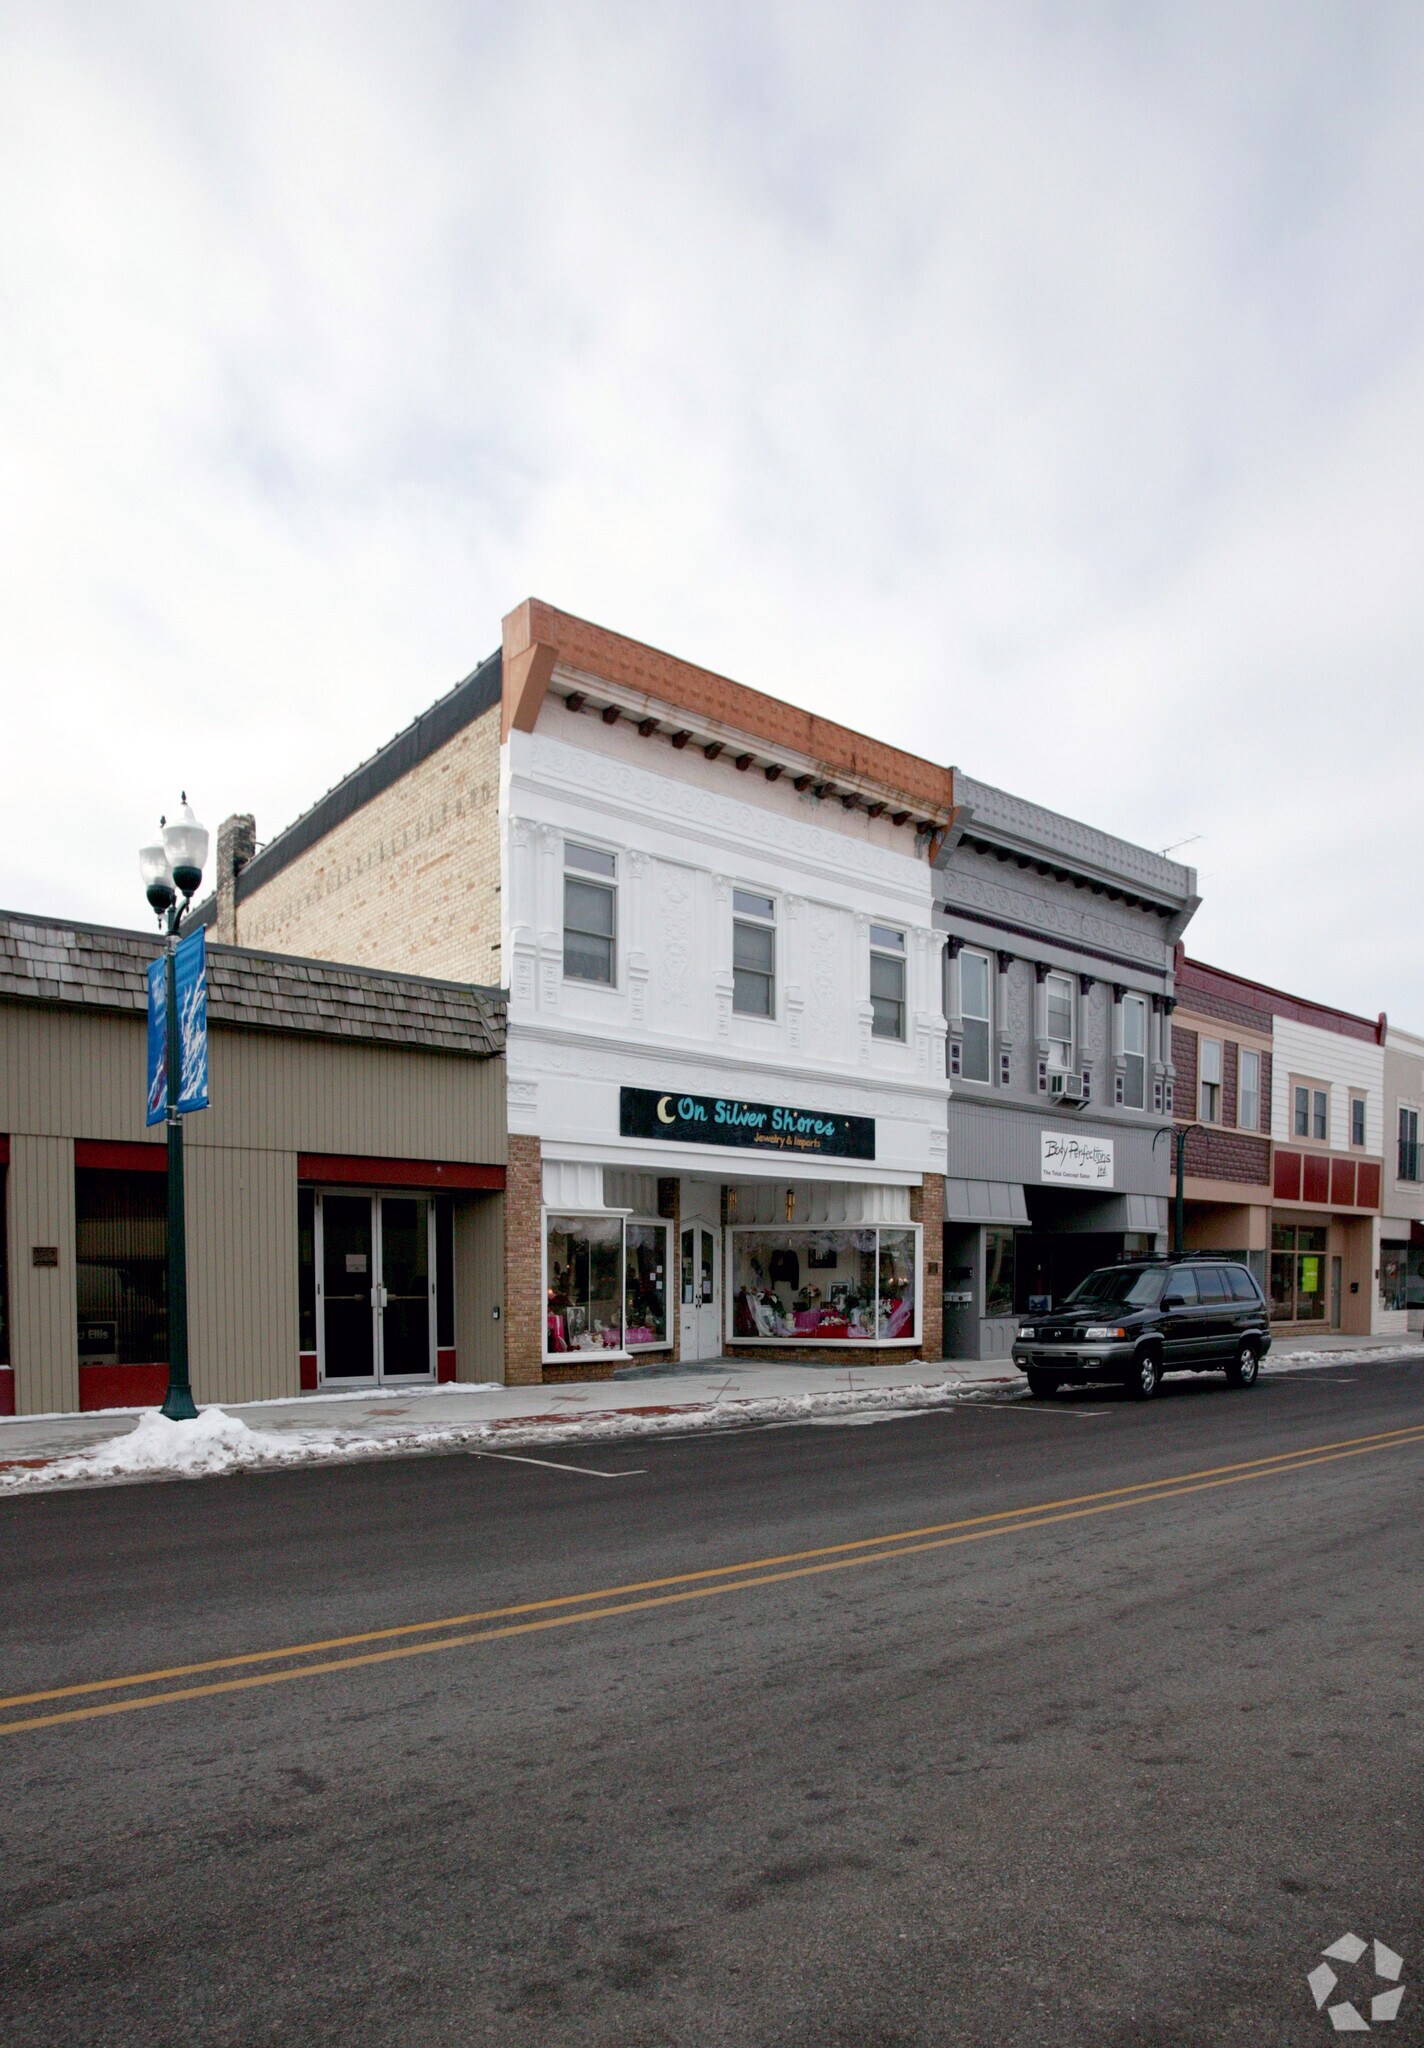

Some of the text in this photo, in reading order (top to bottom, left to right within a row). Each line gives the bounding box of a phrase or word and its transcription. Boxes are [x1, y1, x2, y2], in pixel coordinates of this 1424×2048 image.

[677, 1097, 835, 1136] On Silver Shores
[754, 1132, 821, 1149] Jewelry & Imports
[1045, 1138, 1111, 1167] Body Perfections
[1063, 1171, 1079, 1179] Concept
[88, 1329, 109, 1339] Ellis
